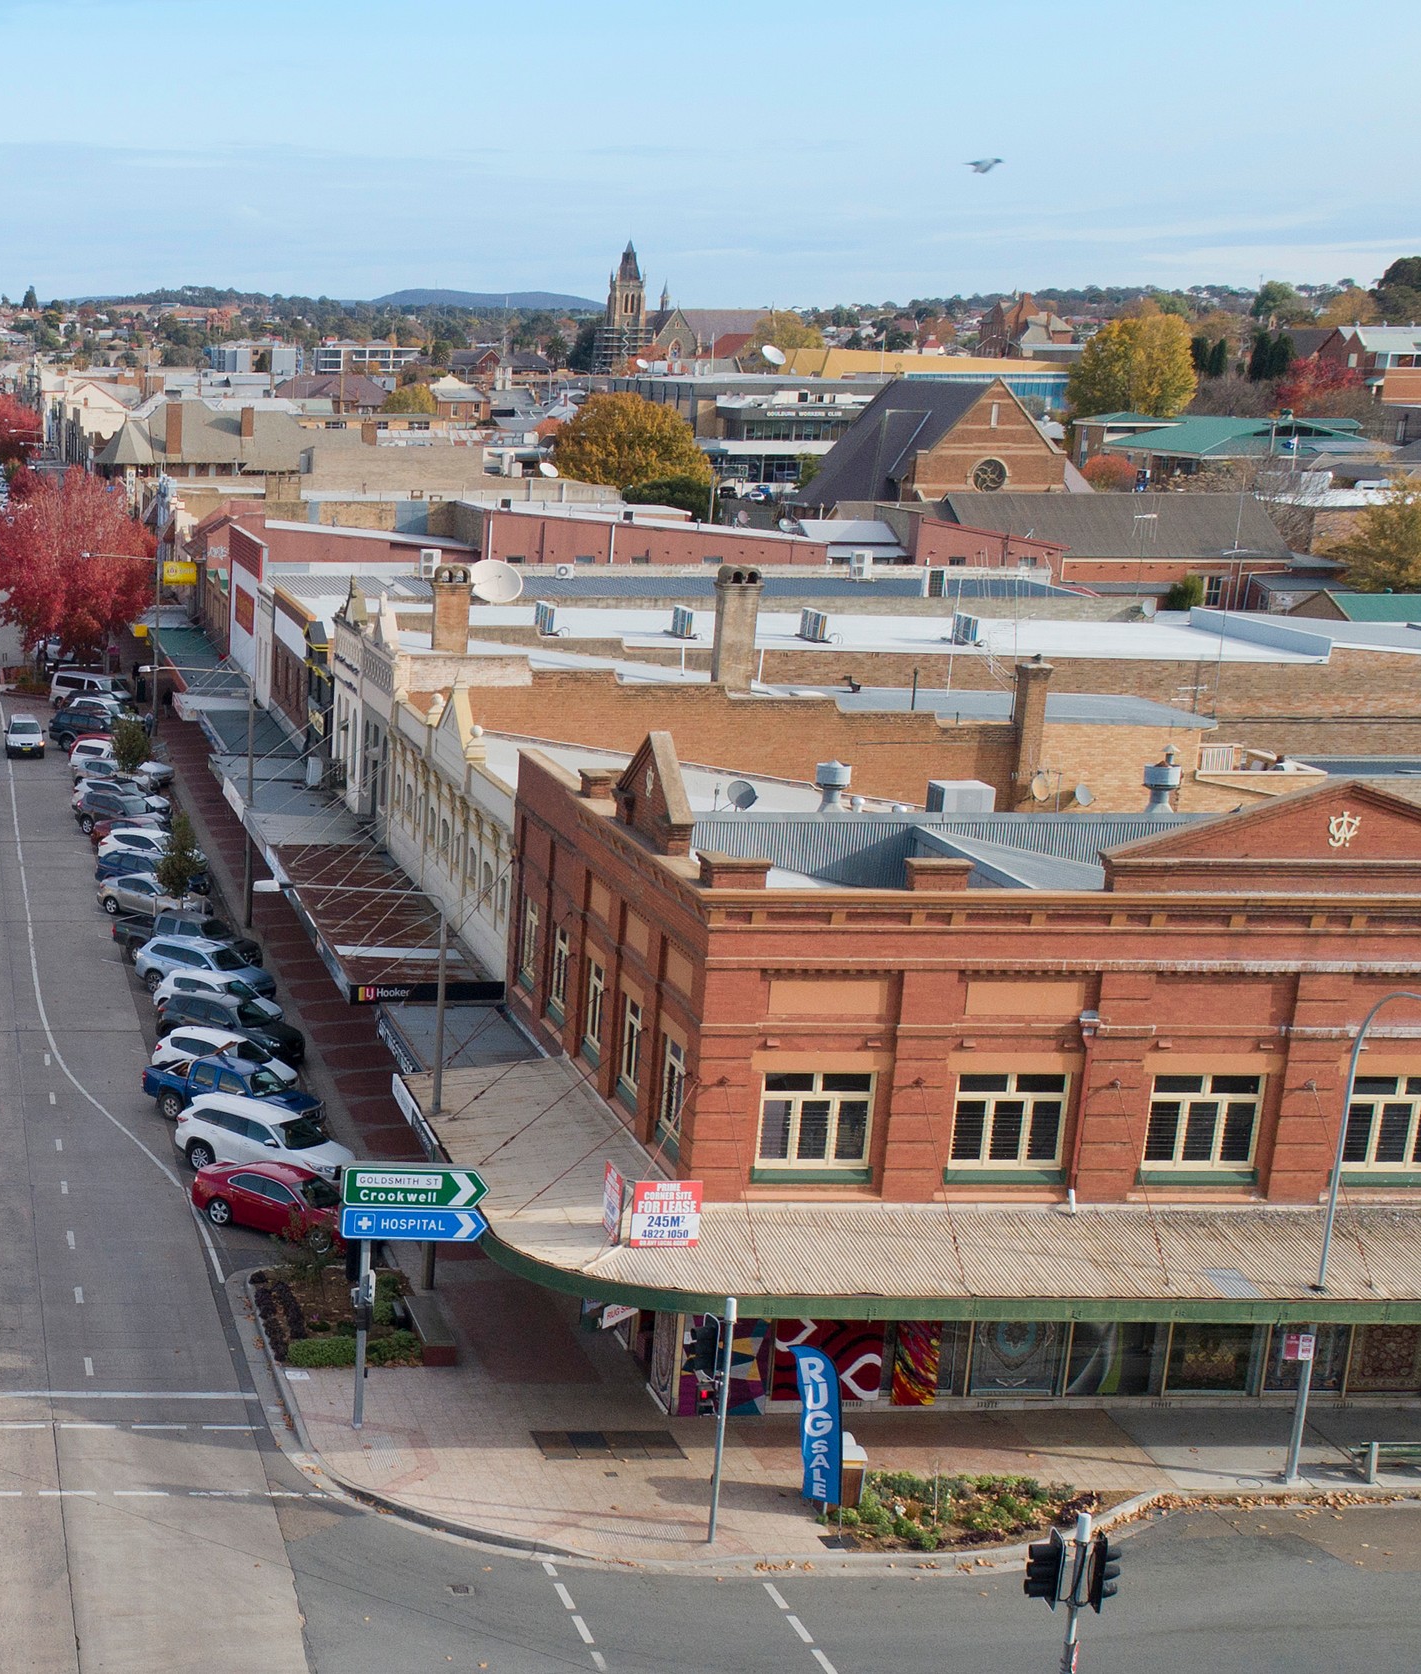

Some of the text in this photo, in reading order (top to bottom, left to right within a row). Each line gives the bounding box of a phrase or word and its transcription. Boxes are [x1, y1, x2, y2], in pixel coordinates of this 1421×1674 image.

[366, 987, 410, 1000] LJ Hooker
[359, 1176, 439, 1186] GOLDSMITH ST
[656, 1183, 681, 1192] PRIME
[359, 1189, 437, 1203] Crookwell
[644, 1191, 693, 1200] CORNER SITE
[637, 1200, 697, 1213] FOR LEASE
[380, 1218, 446, 1231] HOSPITAL
[641, 1229, 689, 1239] 4822 1050
[798, 1356, 833, 1438] RUG
[809, 1439, 830, 1498] SALE
